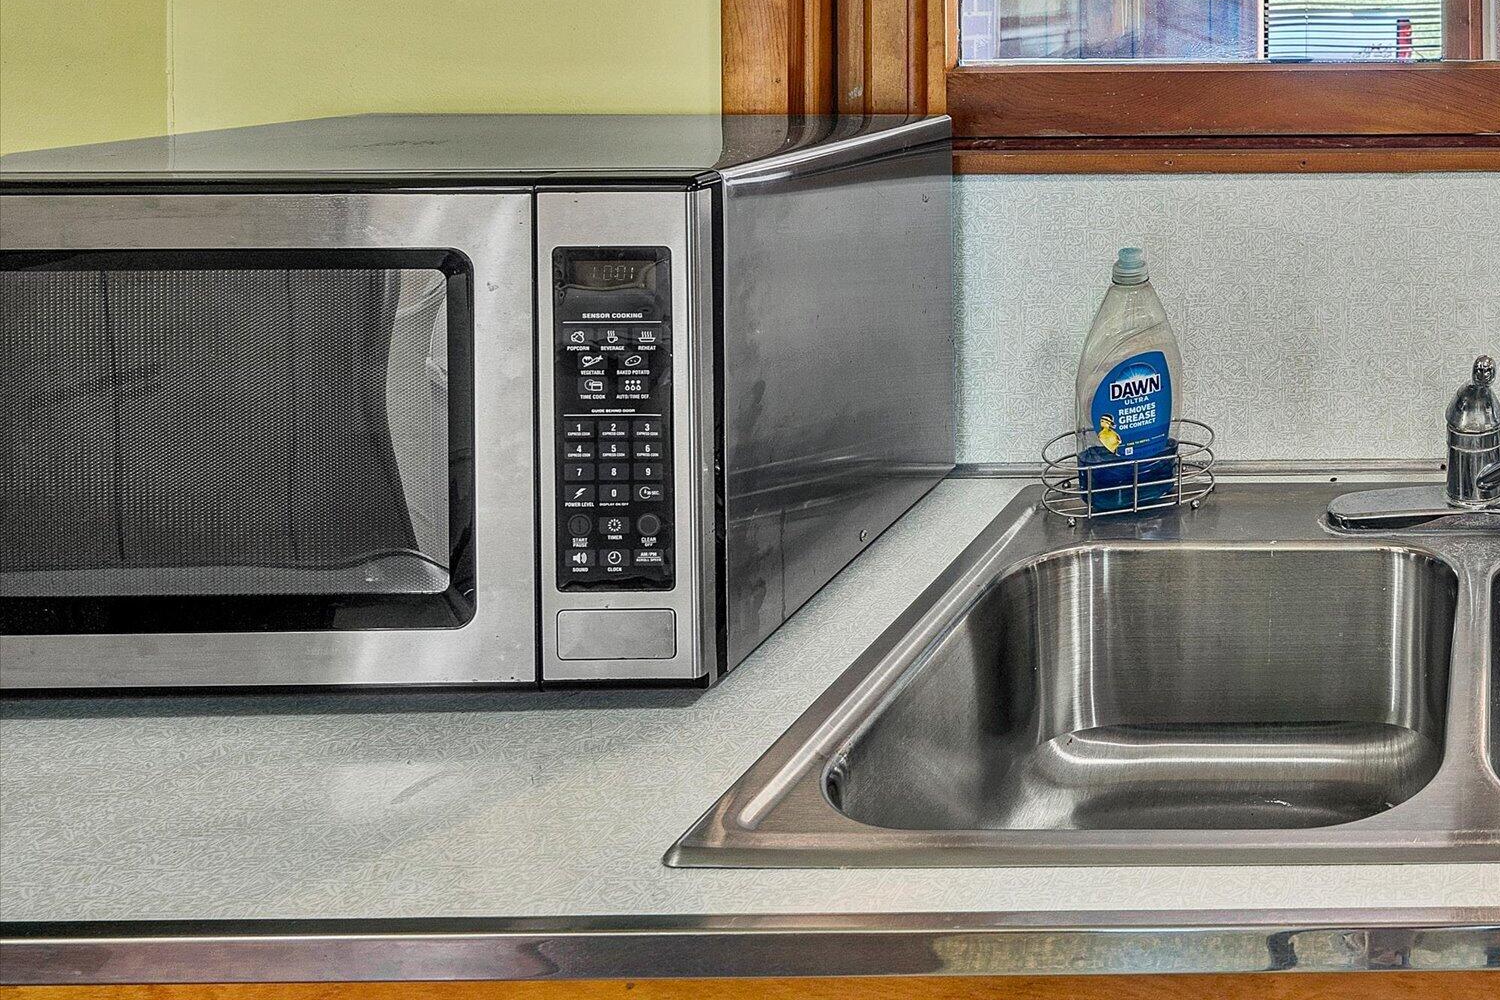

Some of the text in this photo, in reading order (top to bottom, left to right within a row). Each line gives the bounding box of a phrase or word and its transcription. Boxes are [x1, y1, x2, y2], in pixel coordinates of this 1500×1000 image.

[1111, 374, 1160, 400] DAWN
[1124, 396, 1149, 406] ULTRA
[1119, 402, 1156, 416] REMOVES
[1119, 410, 1156, 424] GREASE
[576, 423, 581, 432] 1
[611, 423, 617, 432] 2
[644, 423, 650, 432] 3
[1129, 418, 1156, 429] CONTACT
[576, 445, 582, 453] 4
[611, 445, 617, 453] 5
[645, 444, 651, 453] 6
[576, 468, 582, 477] 7
[611, 468, 617, 477] 8
[645, 467, 651, 476] 9
[611, 489, 617, 498] 0
